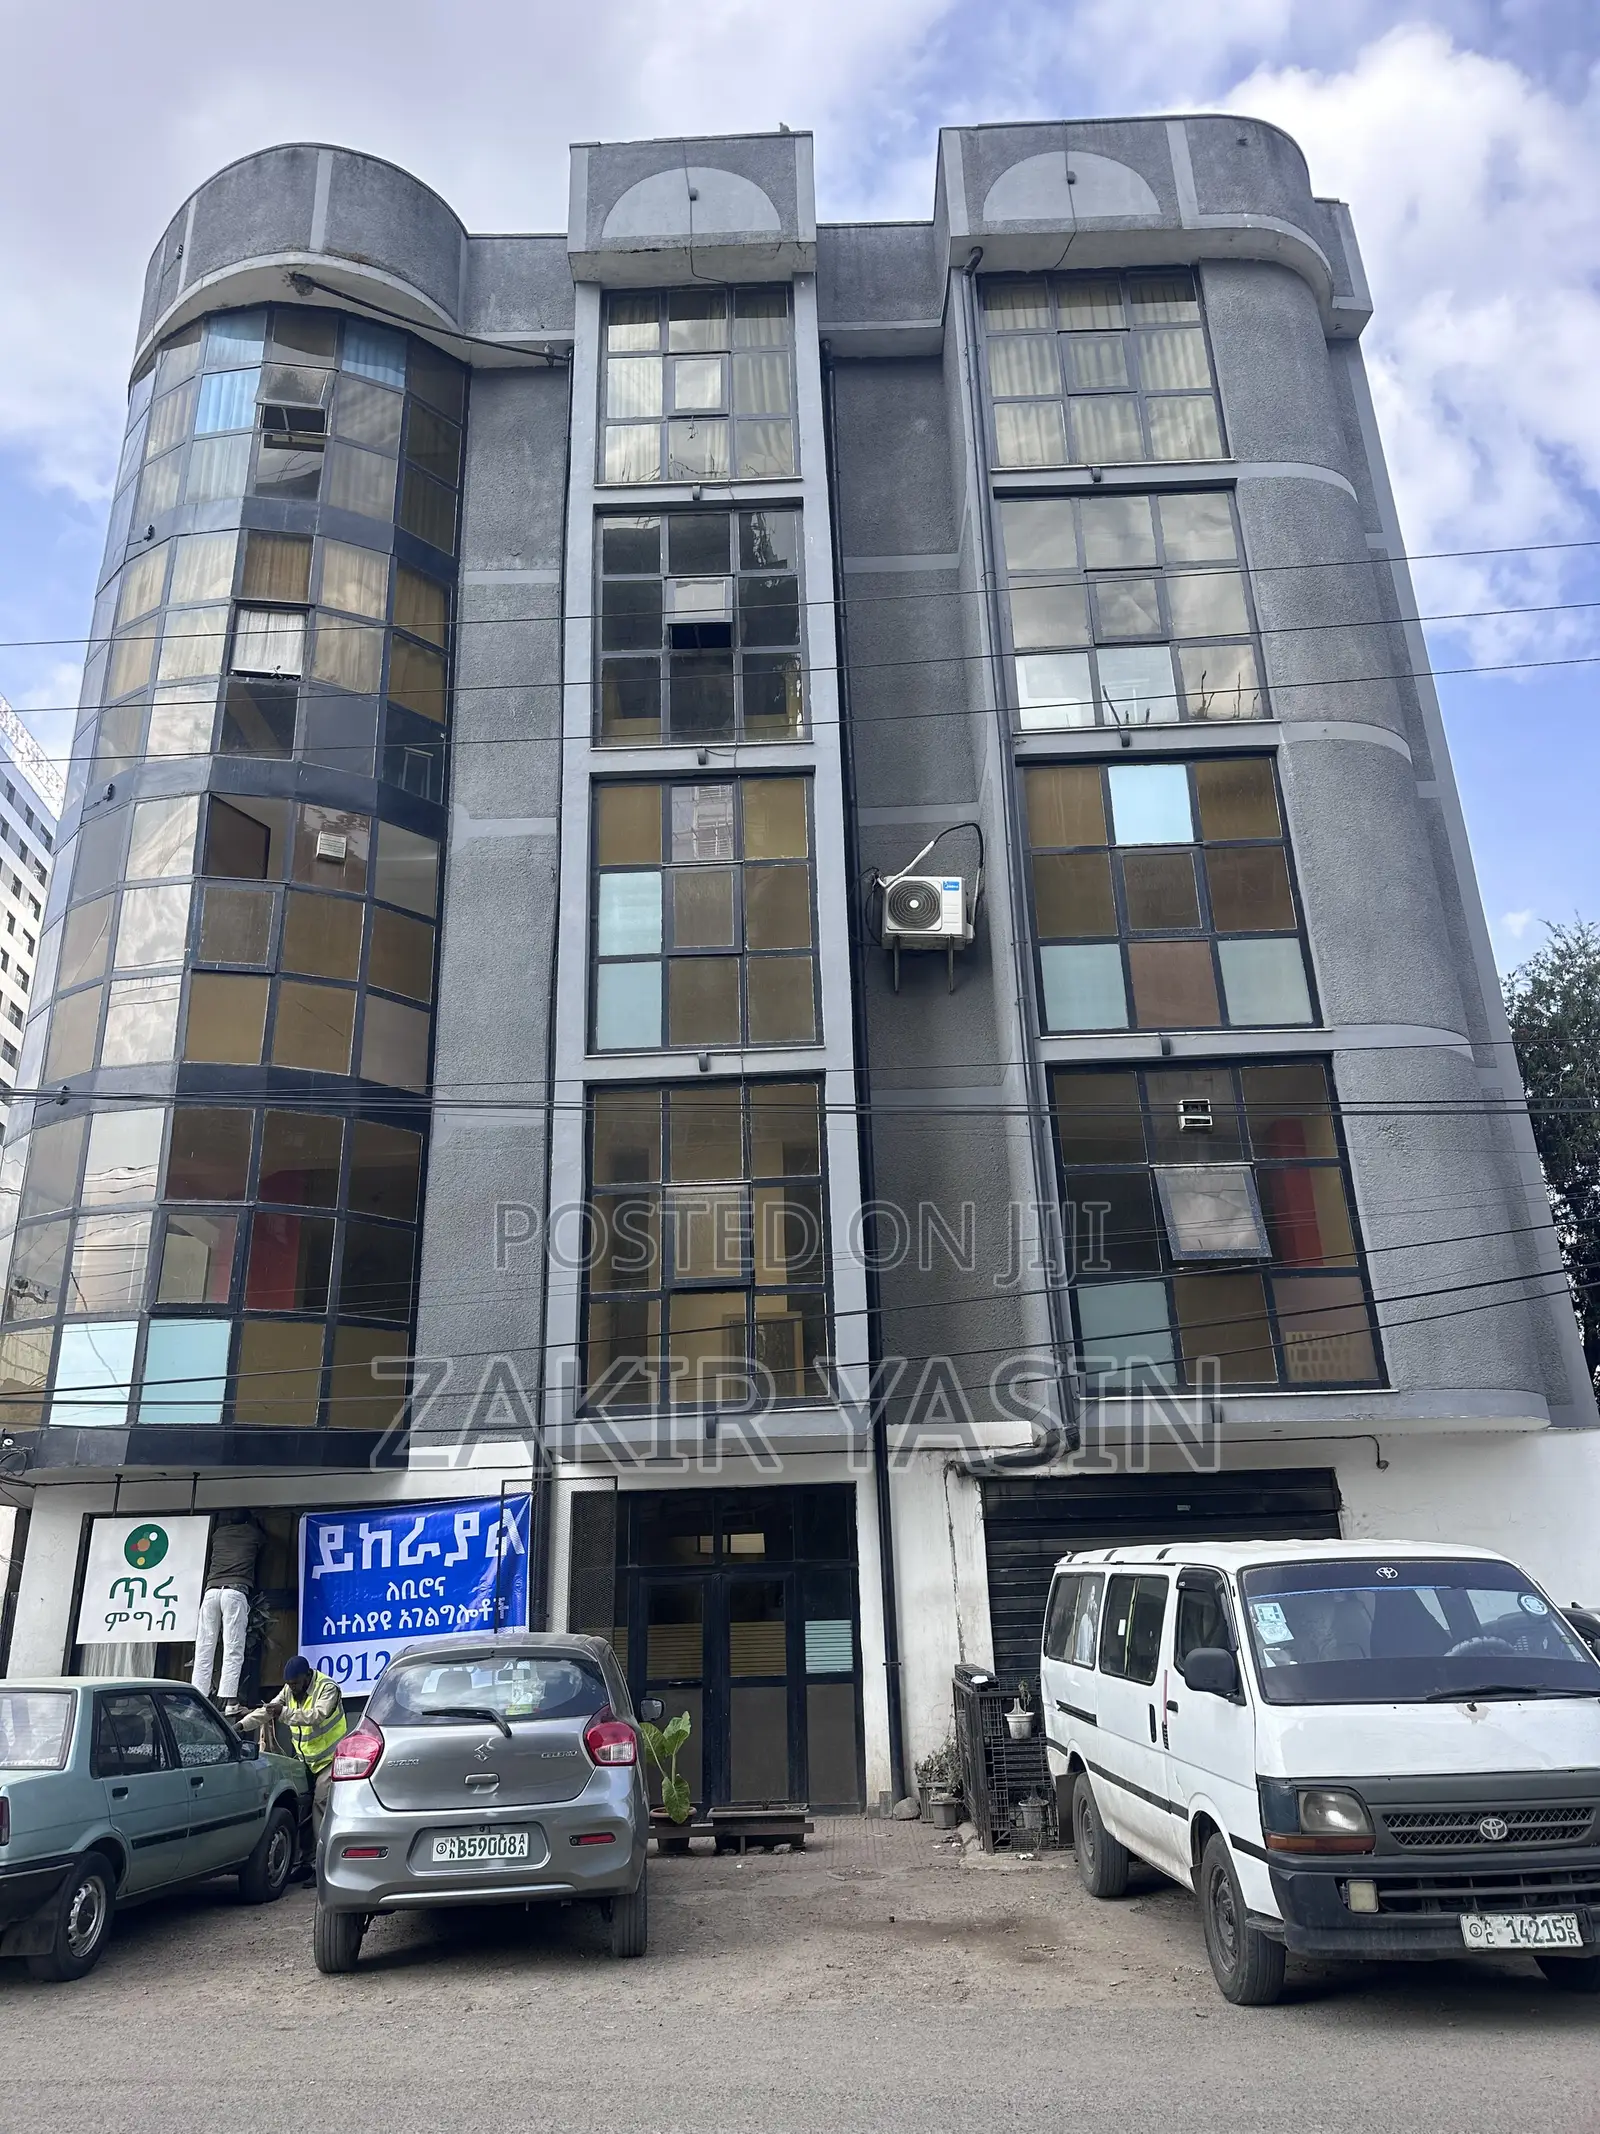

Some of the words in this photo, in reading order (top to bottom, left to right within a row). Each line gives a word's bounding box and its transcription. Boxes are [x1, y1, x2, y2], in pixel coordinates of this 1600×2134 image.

[311, 1508, 526, 1580] ይከራያል
[109, 1576, 178, 1608] ጥሩ
[386, 1576, 446, 1601] ለቢሮና
[104, 1610, 177, 1632] ምግብ
[322, 1610, 393, 1636] ለተለያዩ
[316, 1650, 391, 1684] 0912
[1506, 1919, 1567, 1943] 14215
